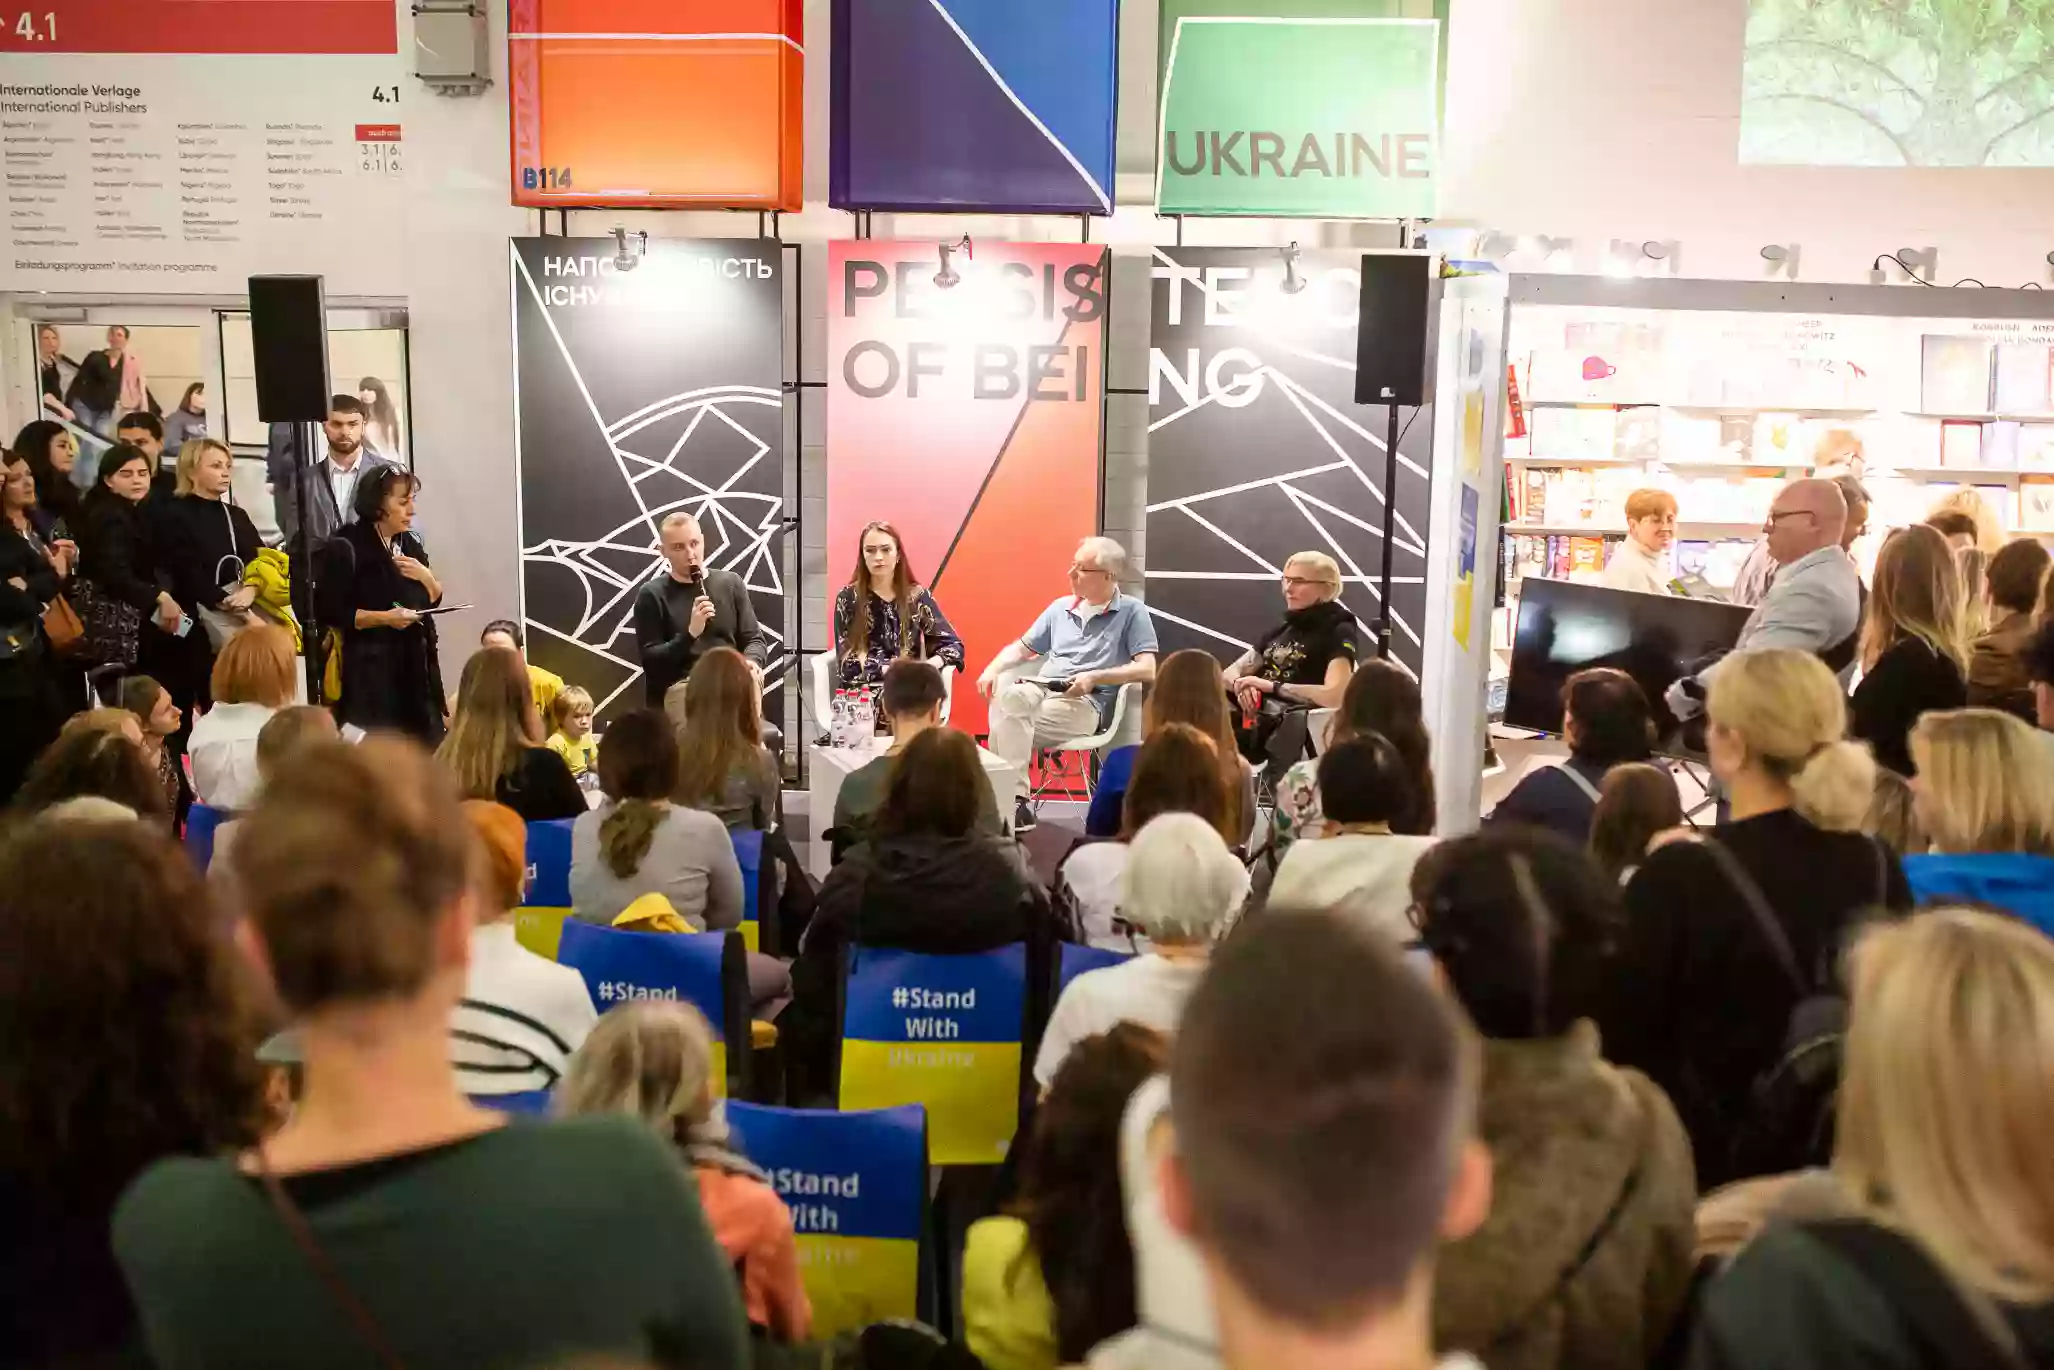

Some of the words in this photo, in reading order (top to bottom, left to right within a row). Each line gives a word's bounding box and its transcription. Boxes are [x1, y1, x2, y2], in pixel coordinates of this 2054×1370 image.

[15, 12, 58, 41] 4.1
[91, 85, 141, 99] Verlage
[372, 85, 400, 103] 4.1
[1, 100, 81, 114] International
[84, 101, 147, 114] Publishers
[1167, 130, 1430, 178] UKRAINE
[523, 167, 572, 189] B114
[844, 259, 1104, 323] PESIS
[842, 340, 949, 399] OF
[974, 344, 1088, 402] BEI
[1149, 347, 1265, 407] NG
[891, 986, 976, 1009] #Stand
[905, 1017, 959, 1039] With
